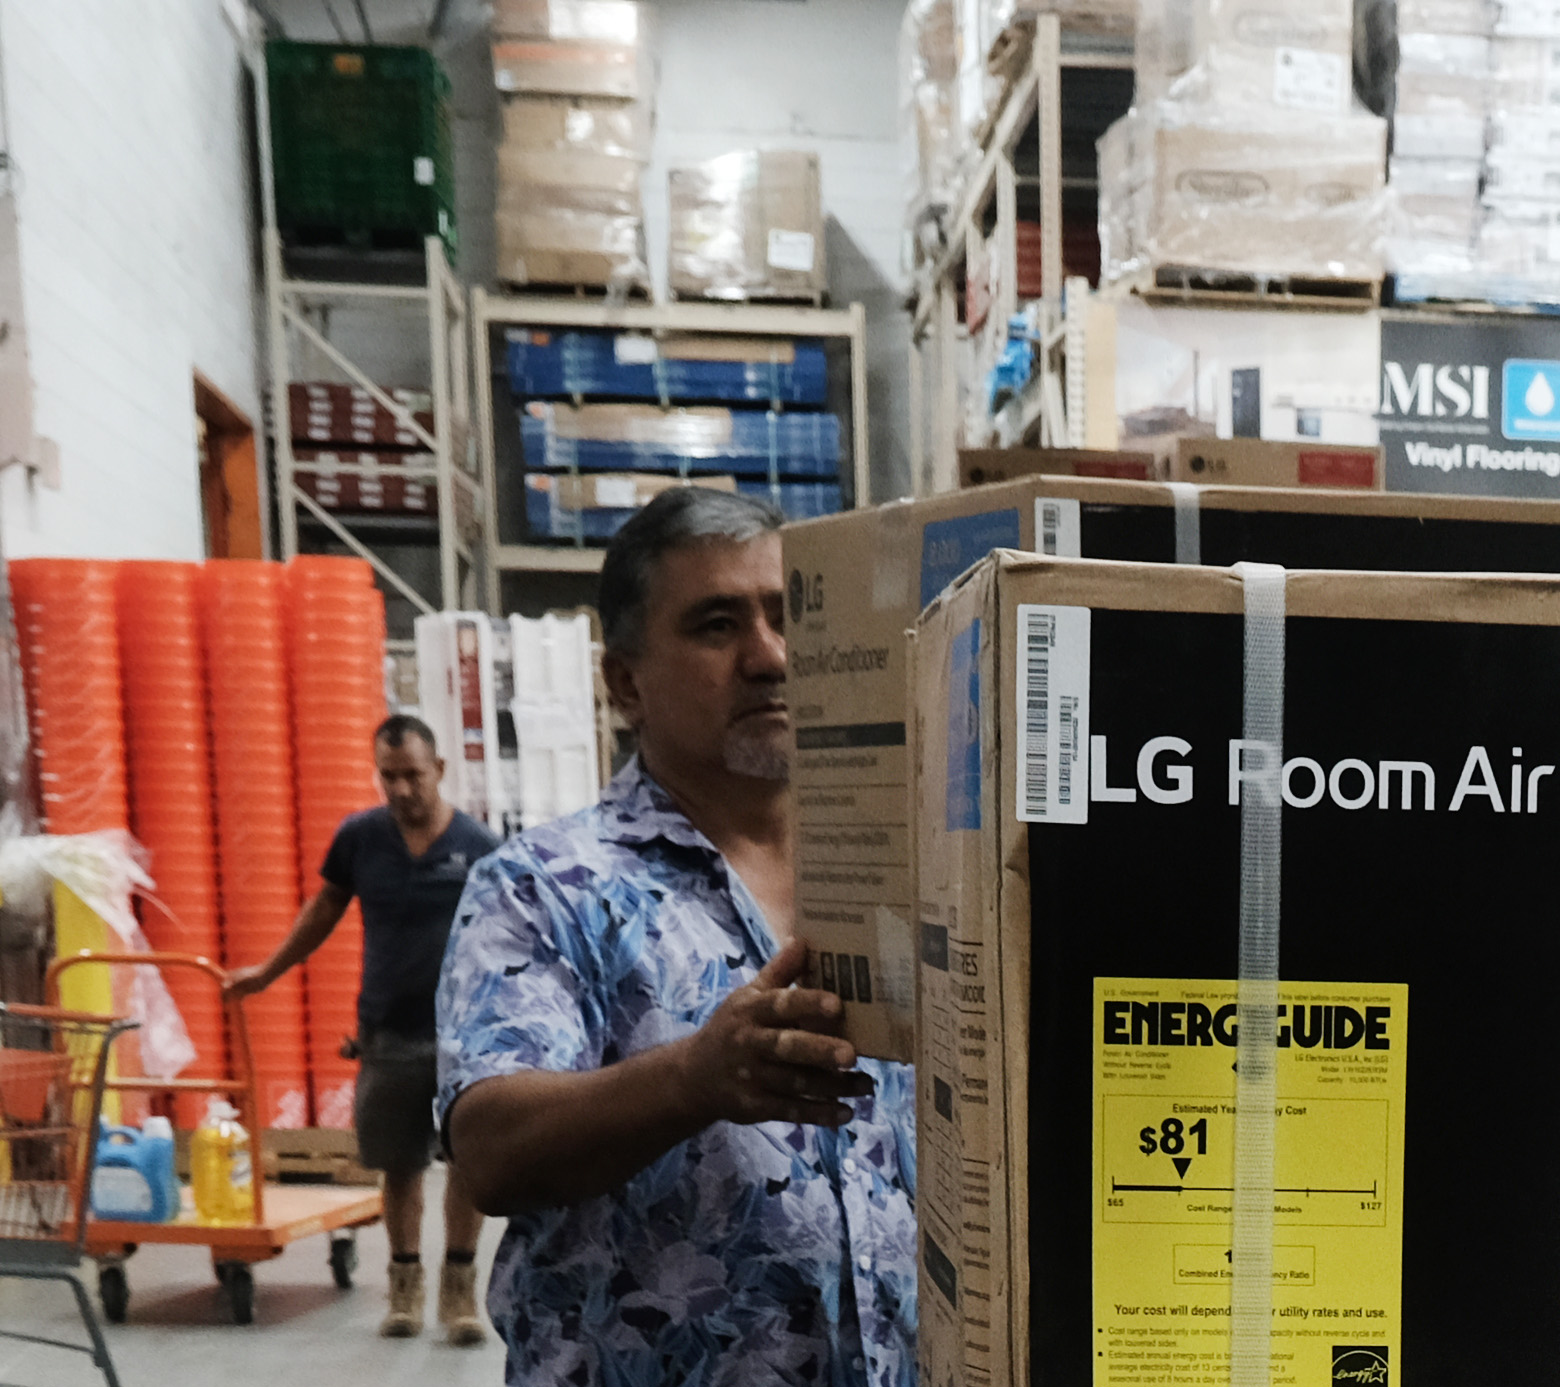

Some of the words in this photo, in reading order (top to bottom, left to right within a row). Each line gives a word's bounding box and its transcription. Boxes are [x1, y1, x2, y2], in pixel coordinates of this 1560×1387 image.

[1380, 360, 1490, 420] MSI
[1404, 441, 1461, 471] Vinyl
[1089, 734, 1194, 805] LG
[1172, 1102, 1221, 1115] Estimated
[1285, 1105, 1308, 1116] Cost
[1138, 1117, 1209, 1158] $81
[1114, 1304, 1138, 1318] Your
[1141, 1306, 1167, 1318] cost
[1279, 1306, 1309, 1321] utility
[1312, 1307, 1339, 1320] rates
[1342, 1307, 1363, 1319] and
[1366, 1309, 1388, 1319] use.
